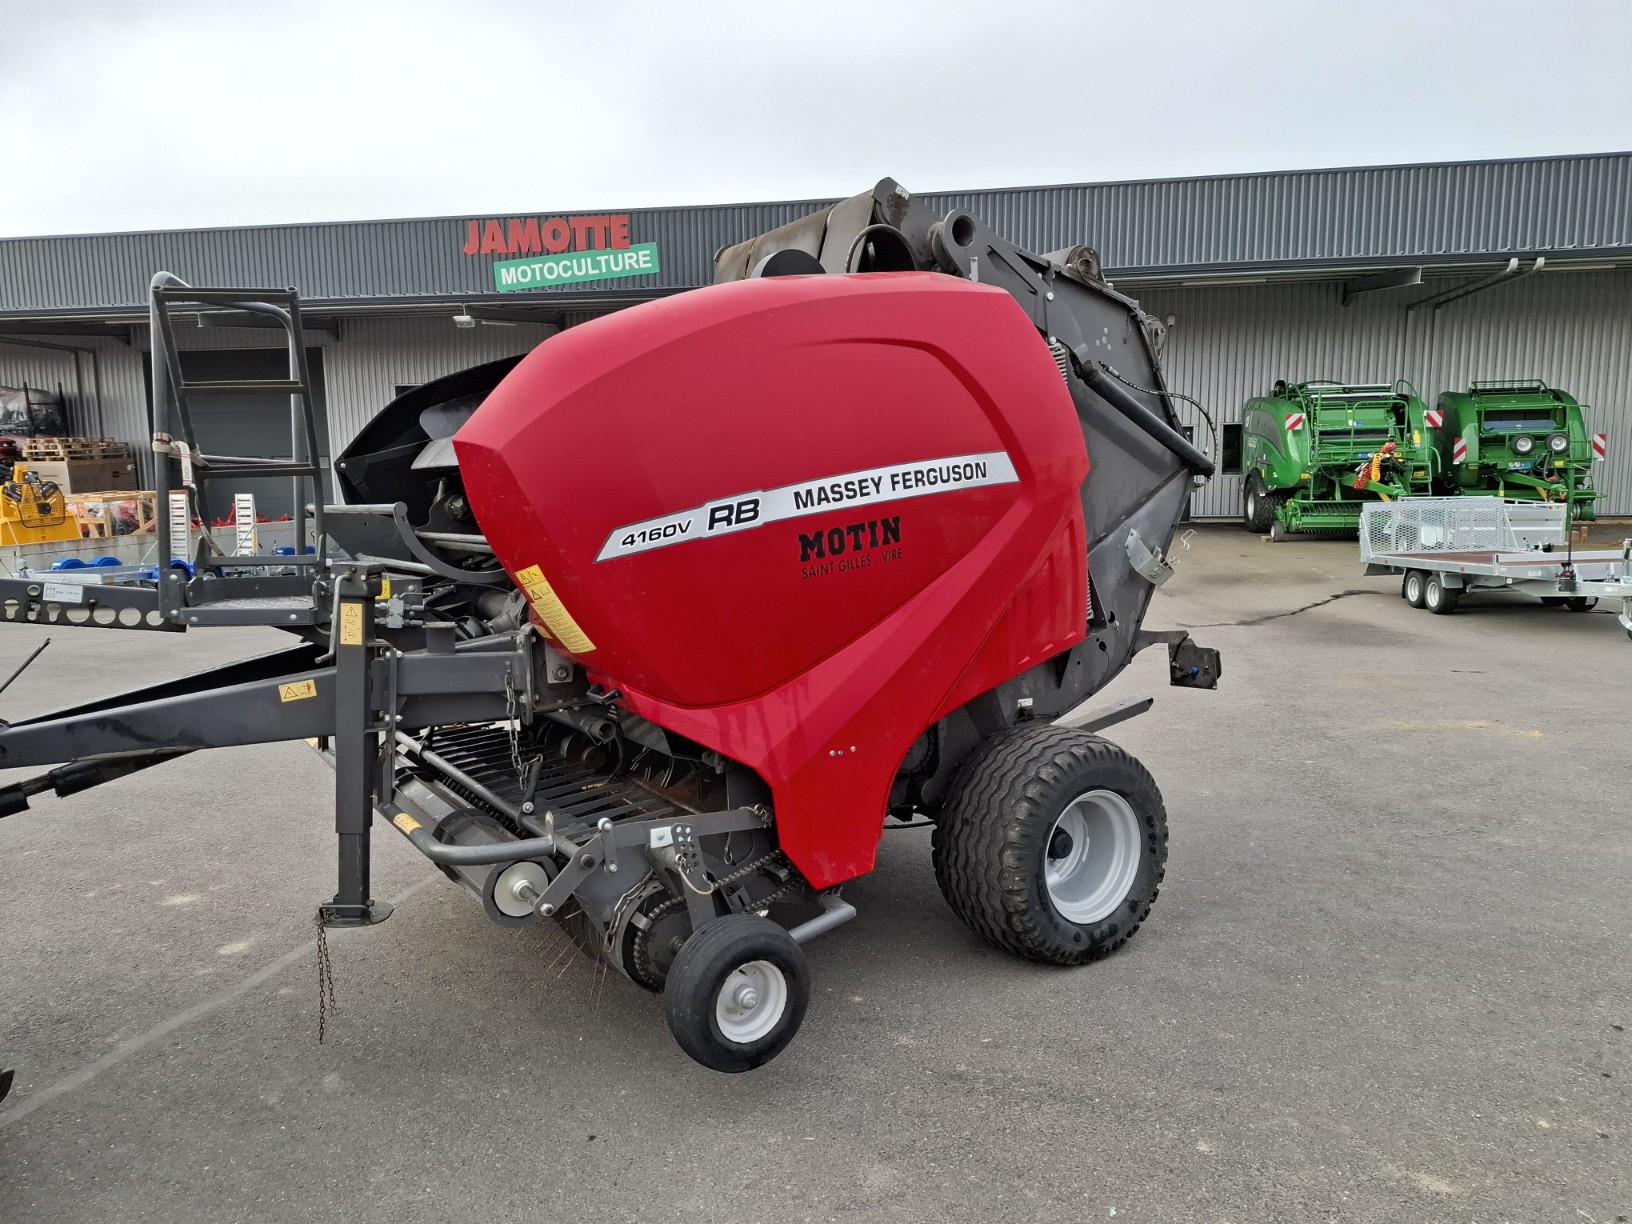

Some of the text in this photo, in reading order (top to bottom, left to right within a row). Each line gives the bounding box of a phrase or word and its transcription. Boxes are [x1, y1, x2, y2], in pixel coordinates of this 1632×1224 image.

[463, 214, 631, 256] JAMOTTE
[500, 250, 652, 285] MOTOCULTURE
[621, 461, 988, 547] 4160V RB MASSEY FERGUSON
[798, 515, 901, 562] MOTIN
[802, 561, 835, 580] SAINT
[838, 554, 872, 572] GILLES
[882, 547, 903, 563] VIRE
